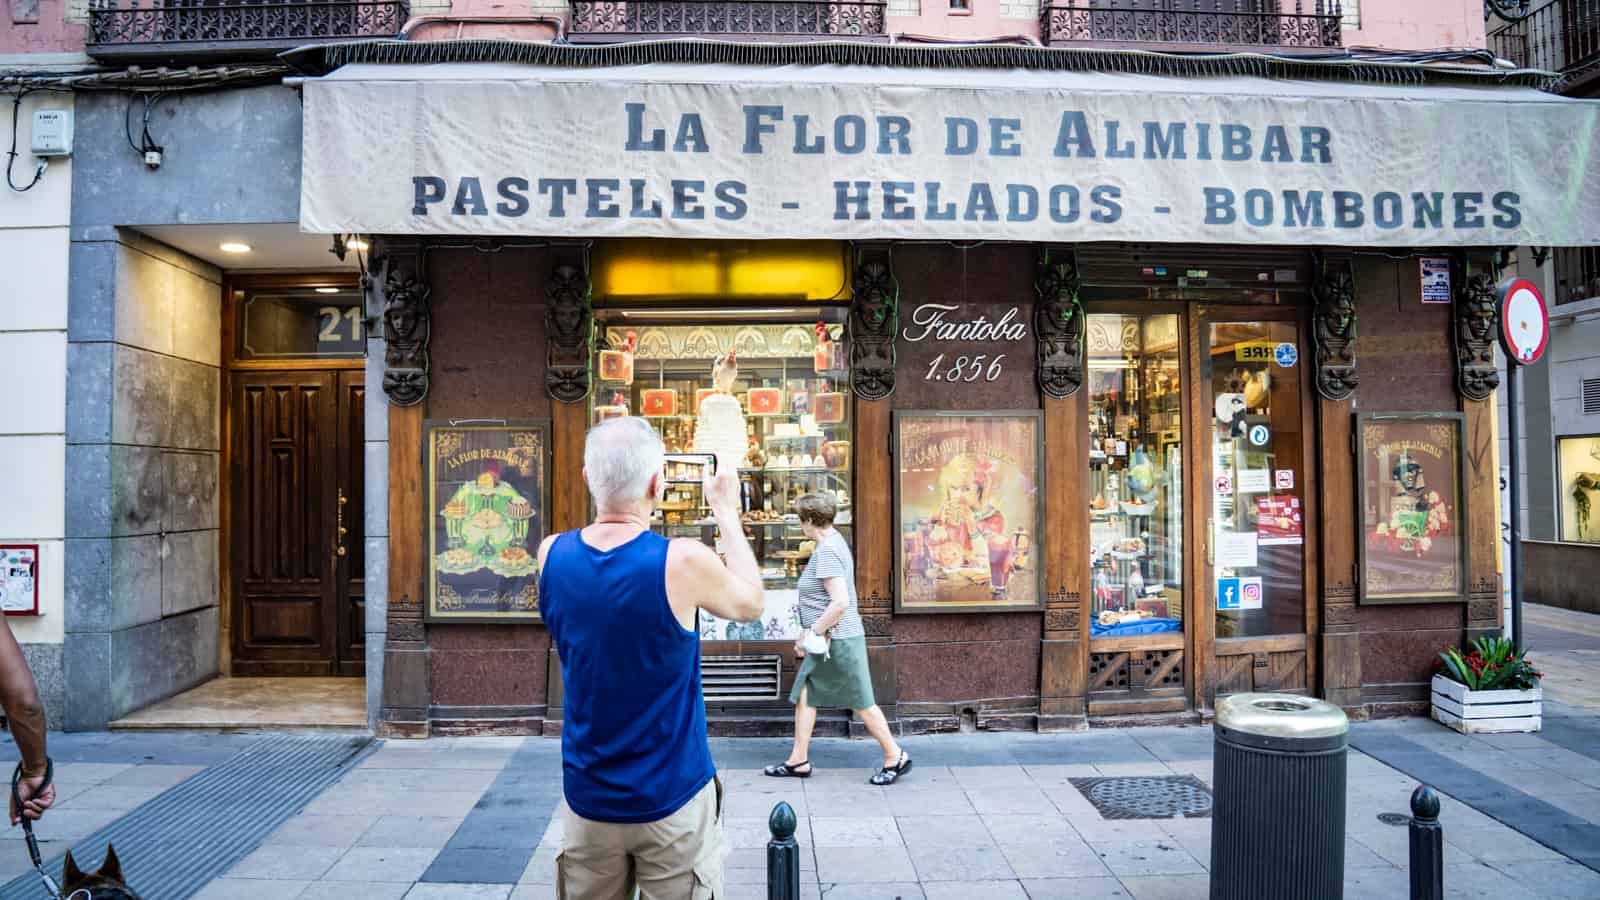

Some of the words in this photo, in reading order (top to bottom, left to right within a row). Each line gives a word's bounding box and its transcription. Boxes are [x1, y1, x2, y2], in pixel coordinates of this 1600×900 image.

[625, 102, 710, 154] LA
[742, 105, 912, 155] FLOR
[945, 117, 1022, 157] DE
[1053, 110, 1334, 165] ALMIBAR
[411, 176, 748, 220] PASTELES
[832, 181, 1124, 224] HELADOS
[1203, 187, 1523, 230] BOMBONES
[319, 306, 361, 341] 21
[903, 303, 1027, 341] Fantoba
[925, 353, 1007, 382] 1.856
